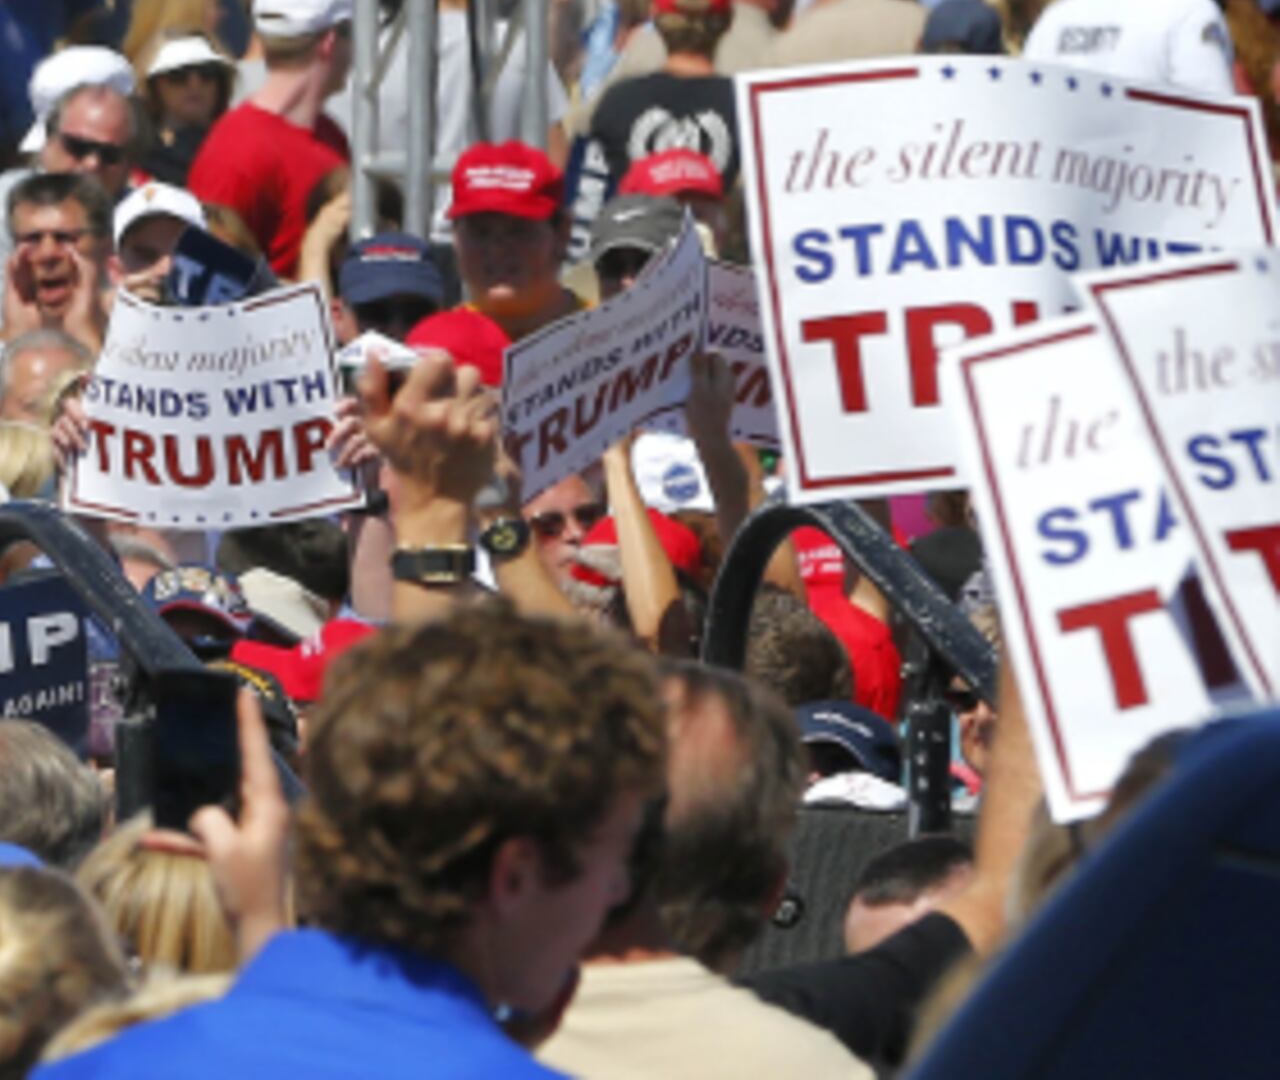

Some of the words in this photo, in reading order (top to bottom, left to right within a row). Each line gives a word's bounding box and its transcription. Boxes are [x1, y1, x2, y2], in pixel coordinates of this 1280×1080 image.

[784, 128, 874, 194] the
[885, 119, 1044, 183] silent
[1052, 144, 1240, 228] majority
[793, 214, 1081, 284] STANDS
[89, 378, 211, 419] STANDS
[223, 370, 328, 417] WITH
[1155, 326, 1234, 396] the
[503, 332, 694, 469] TRUMP
[1014, 395, 1125, 472] the
[88, 416, 335, 488] TRUMP
